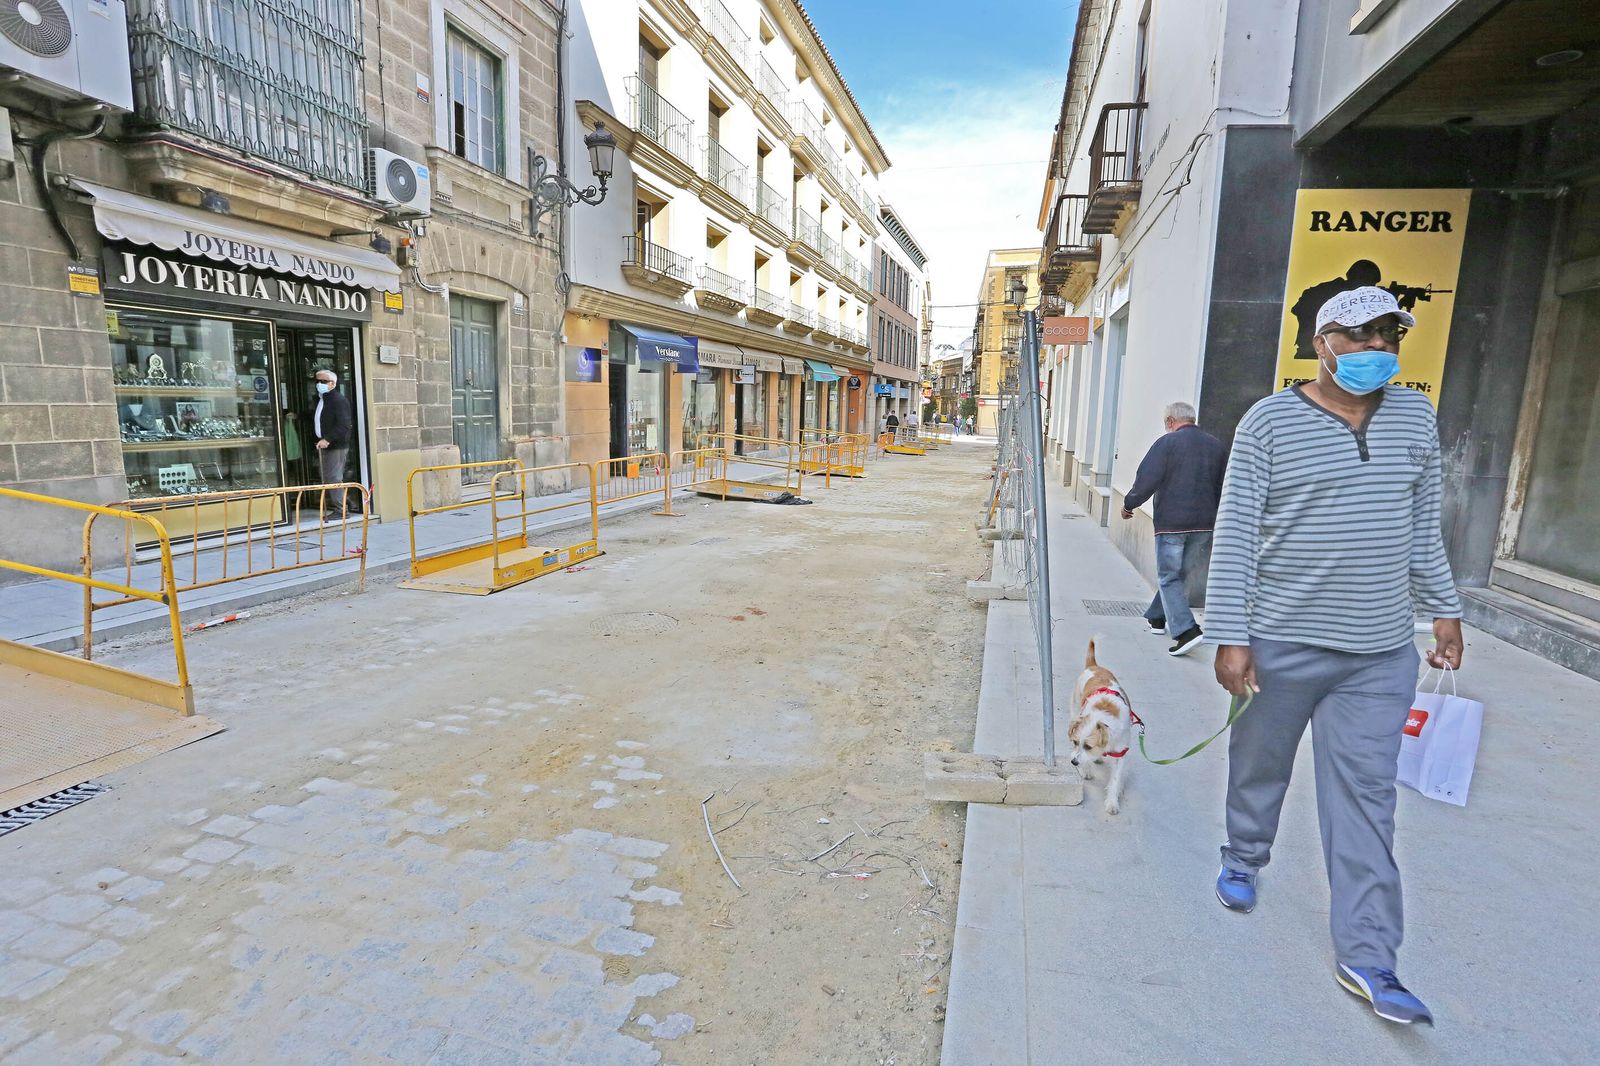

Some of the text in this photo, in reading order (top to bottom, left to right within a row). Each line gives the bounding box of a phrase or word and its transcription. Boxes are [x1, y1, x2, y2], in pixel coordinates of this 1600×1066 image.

[1309, 210, 1453, 233] RANGER
[183, 230, 355, 281] JOYERIA NANDO
[119, 252, 368, 313] JOYERÍA NANDO
[1044, 326, 1085, 336] GOCCO
